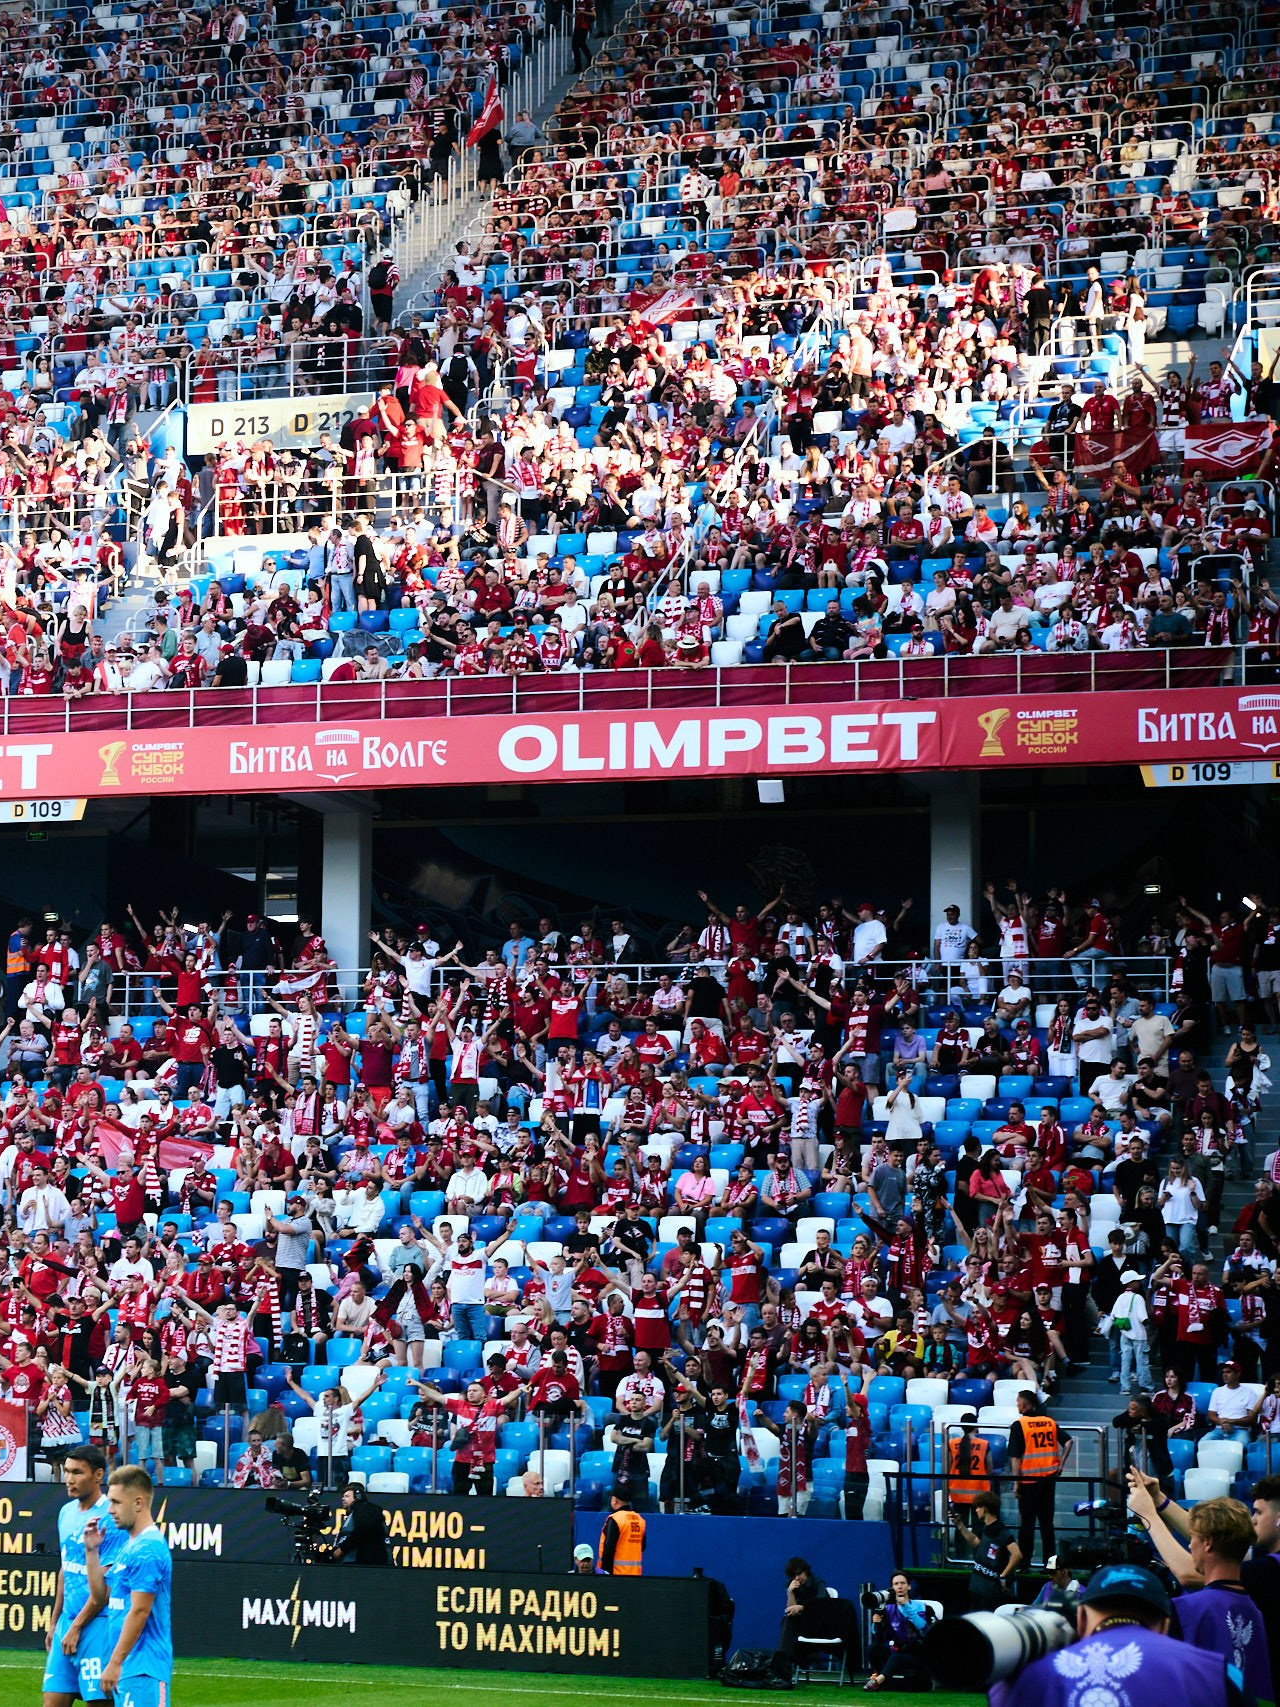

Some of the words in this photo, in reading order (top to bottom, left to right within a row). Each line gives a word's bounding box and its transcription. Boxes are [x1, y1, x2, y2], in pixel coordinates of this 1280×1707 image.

[212, 418, 224, 437] D
[234, 416, 269, 436] 213
[294, 413, 308, 433] D
[318, 410, 354, 432] 212
[1017, 709, 1078, 719] OLIMPBET
[1017, 719, 1078, 733] СУПЕР
[131, 742, 185, 751] OLIMPBET
[498, 711, 936, 773] OLIMPBET
[1017, 732, 1078, 746] КУБОК
[131, 751, 184, 764] СУПЕР
[1028, 746, 1067, 754] РОССИИ
[131, 763, 184, 776] КУБОК
[1172, 766, 1184, 781] D
[1191, 763, 1231, 782] 109
[140, 776, 174, 784] РОССИИ
[14, 804, 24, 818] D
[30, 801, 61, 818] 109
[1031, 1431, 1055, 1449] 129
[437, 1586, 501, 1615] ЕСЛИ
[510, 1589, 597, 1622] РАДИО
[436, 1621, 469, 1650] ТО
[476, 1623, 620, 1658] MAXIMUM!
[80, 1657, 101, 1680] 28
